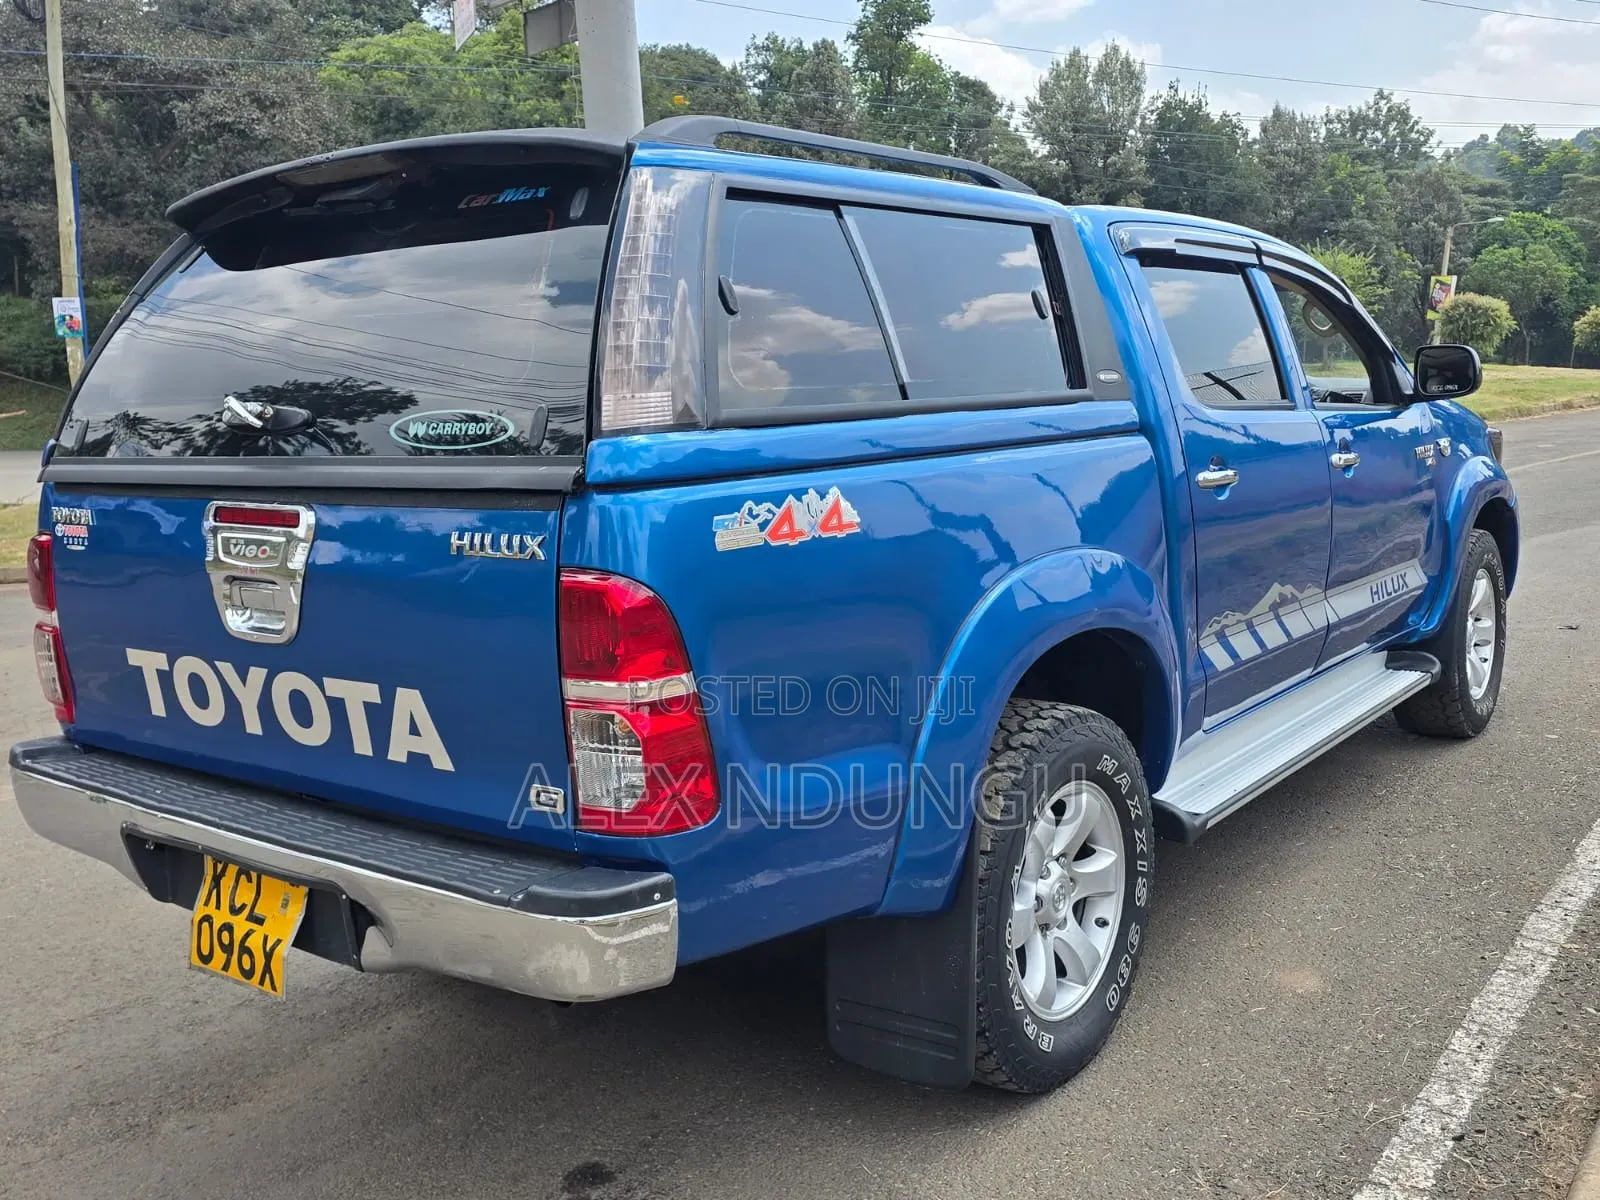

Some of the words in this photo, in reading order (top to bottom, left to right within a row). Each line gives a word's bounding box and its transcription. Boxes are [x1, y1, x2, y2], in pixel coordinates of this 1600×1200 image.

[428, 422, 493, 435] CARRYBOY
[450, 531, 546, 561] HILUX
[1370, 571, 1409, 604] HILUX
[125, 647, 456, 772] TOYOTA
[1096, 754, 1149, 908] MAXXIS
[196, 914, 284, 993] 096X
[1106, 921, 1142, 1012] 980
